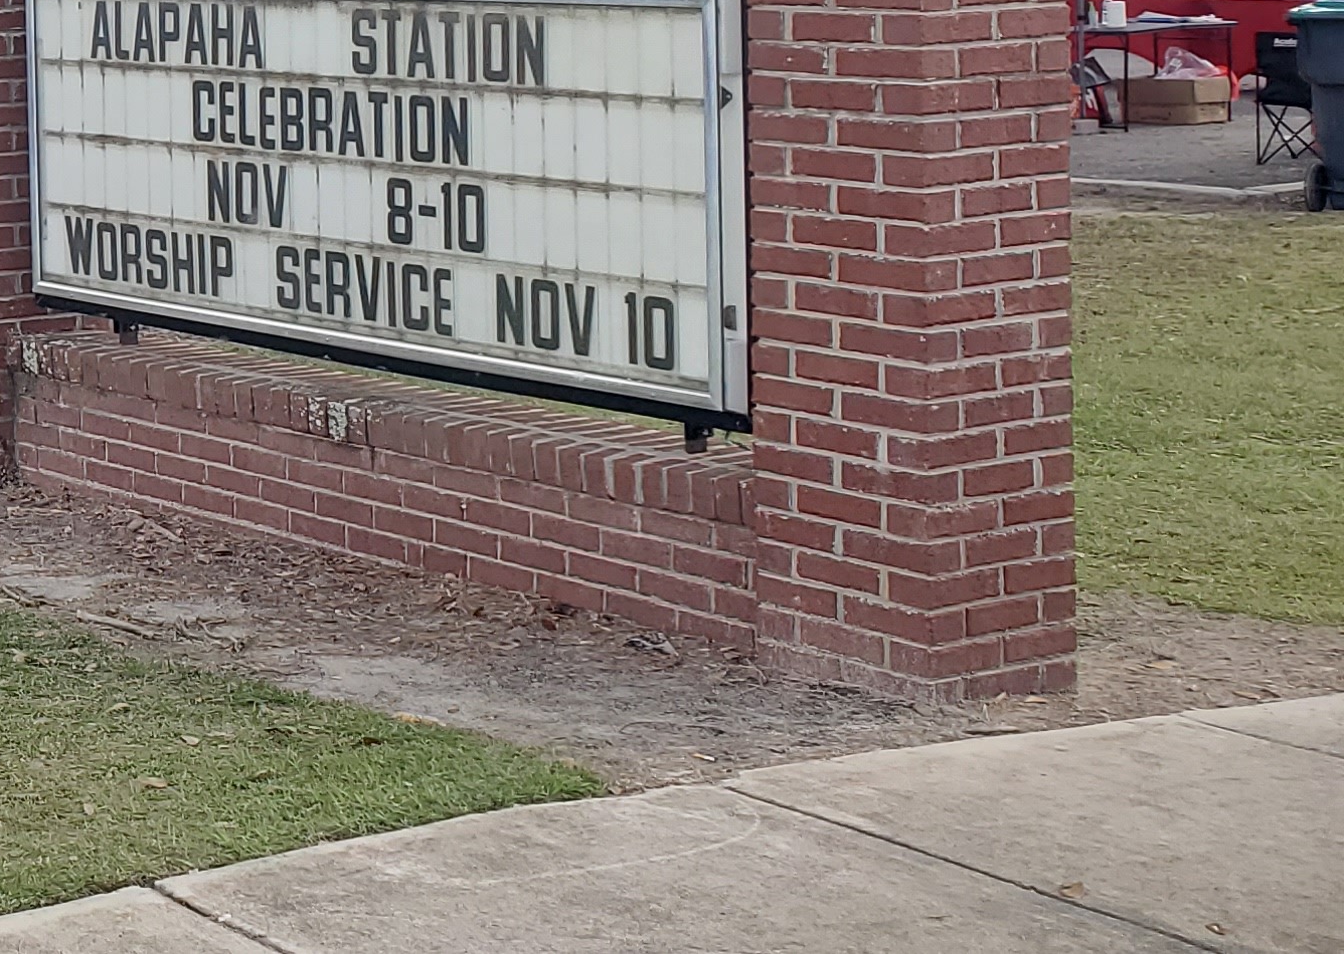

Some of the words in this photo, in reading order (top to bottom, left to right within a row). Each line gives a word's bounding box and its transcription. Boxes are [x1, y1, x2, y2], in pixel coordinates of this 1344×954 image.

[91, 1, 263, 69] ALAPAHA
[351, 9, 545, 86] STATION
[192, 80, 469, 165] CELEBRATION
[207, 160, 287, 228] NOV
[386, 177, 485, 253] 8-10
[65, 216, 233, 297] WORSHIP
[275, 246, 453, 336] SERVICE
[496, 273, 595, 356] NOV
[624, 291, 674, 370] 10
